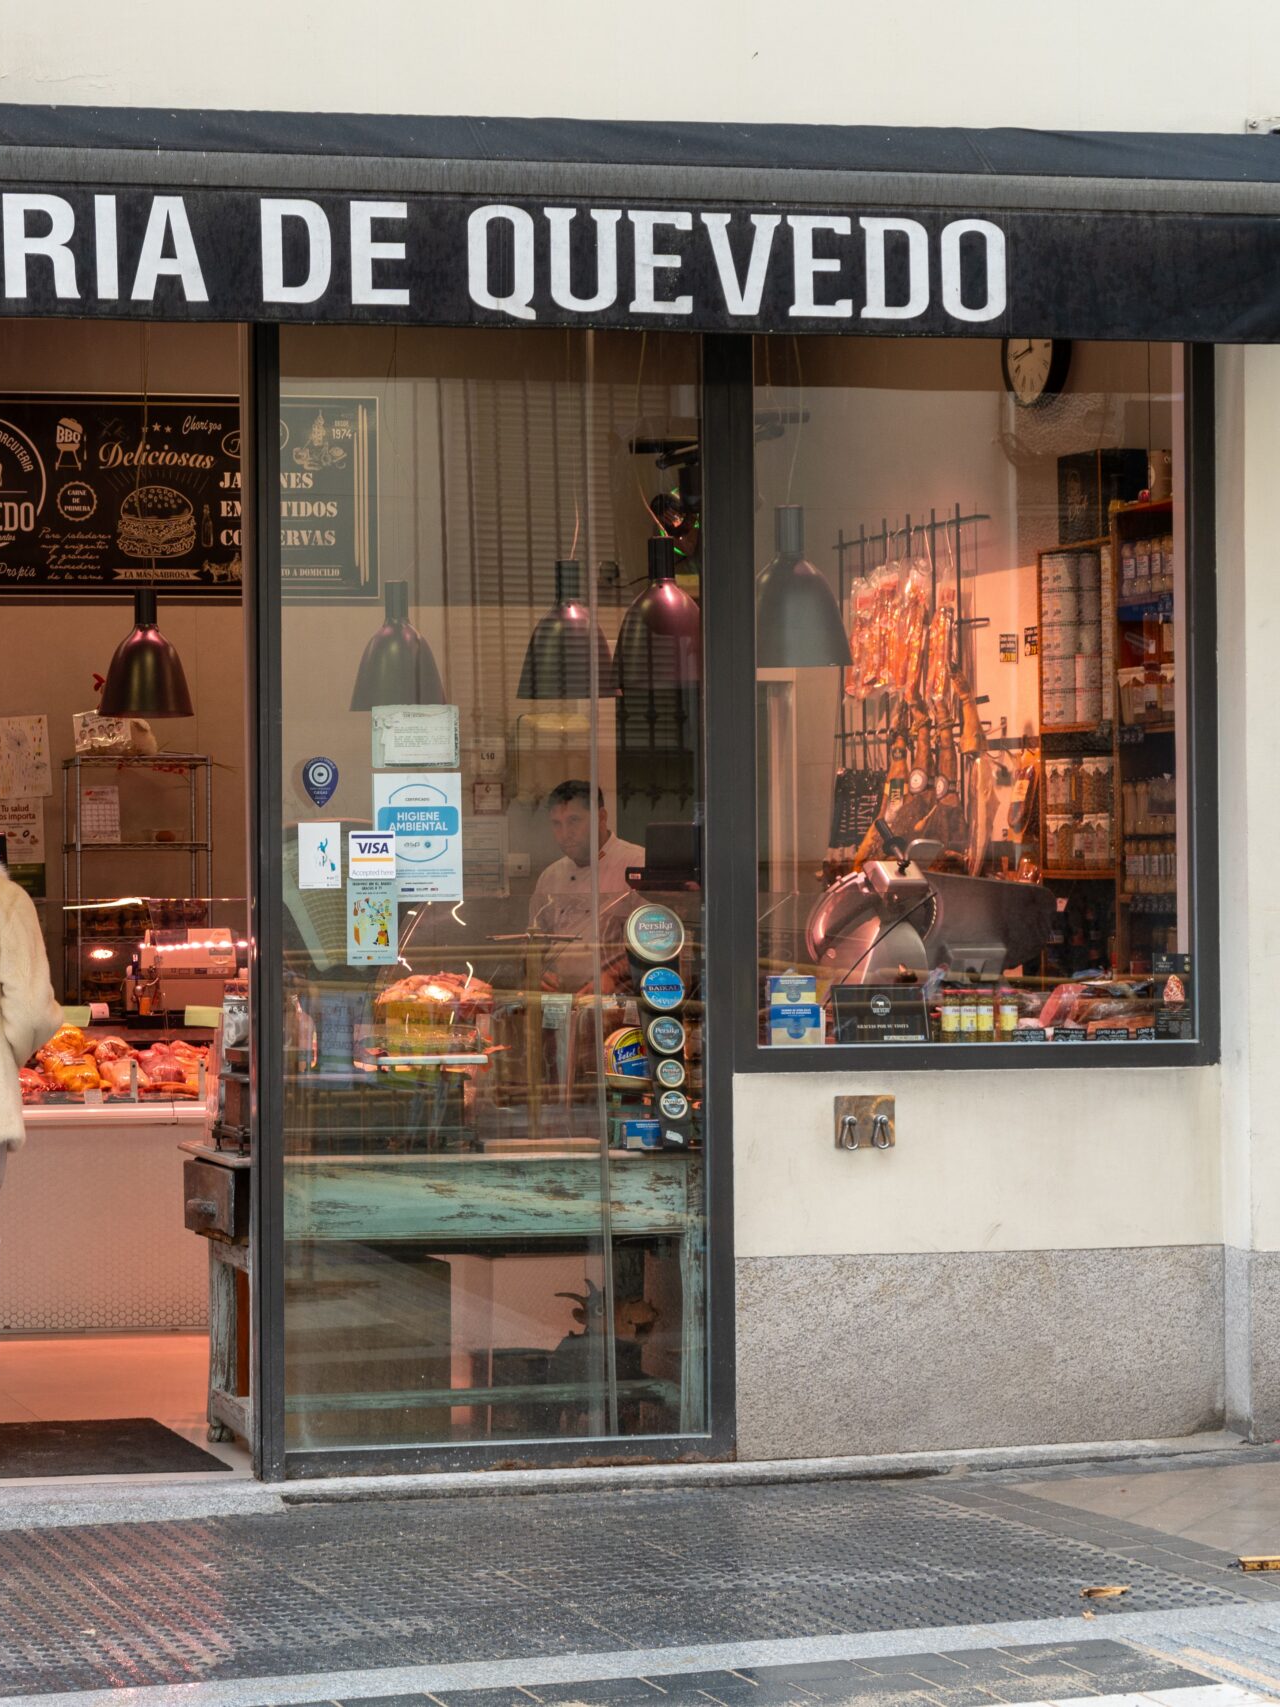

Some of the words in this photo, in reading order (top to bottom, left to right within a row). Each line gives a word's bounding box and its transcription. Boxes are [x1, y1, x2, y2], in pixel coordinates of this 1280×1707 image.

[259, 198, 411, 305] DE
[466, 204, 1007, 322] QUEVEDO
[182, 415, 223, 435] Chorizos
[56, 425, 81, 444] BBQ
[332, 428, 352, 440] 1974
[99, 441, 216, 470] Deliciosas
[219, 471, 314, 489] JANES
[153, 571, 190, 579] SABROSA
[299, 567, 340, 577] DOMICILIO
[10, 804, 29, 812] salud
[8, 813, 36, 821] importa
[397, 812, 439, 821] HIGIENE
[389, 822, 448, 831] AMBIENTAL
[356, 843, 389, 854] VISA
[351, 869, 380, 877] Accepted
[638, 921, 673, 932] Persika
